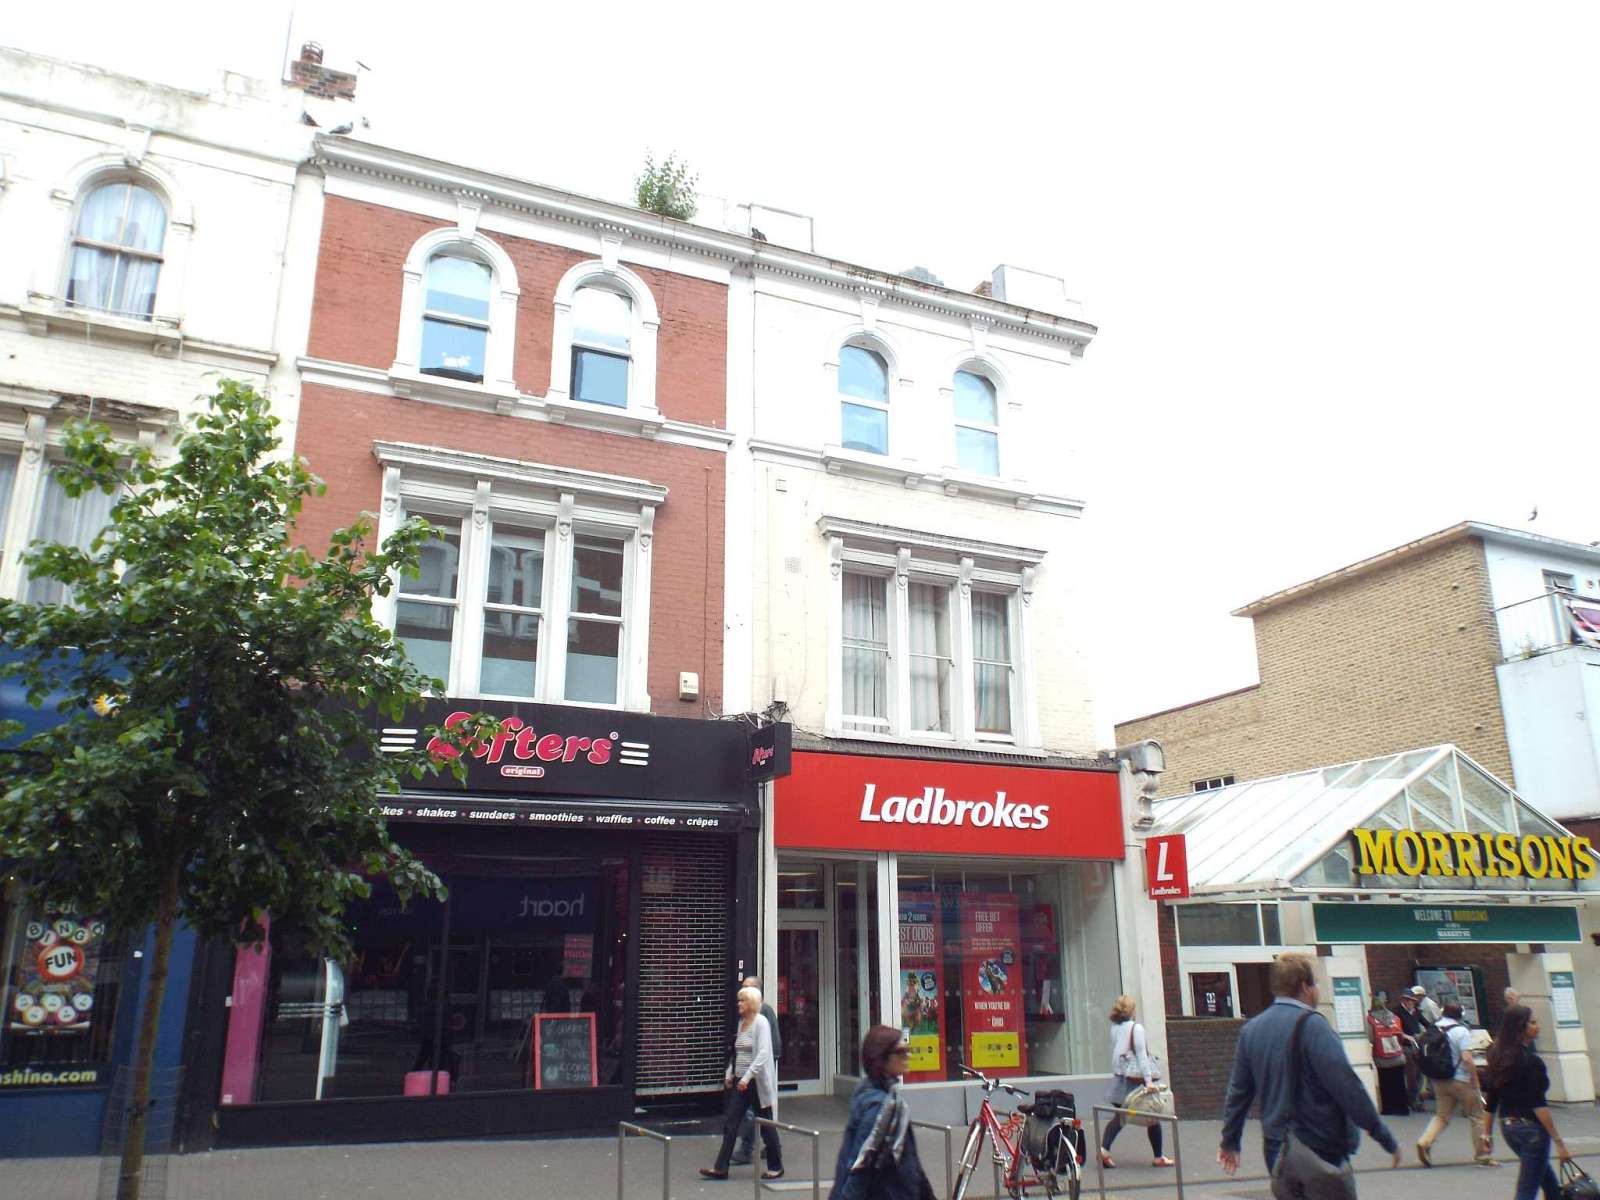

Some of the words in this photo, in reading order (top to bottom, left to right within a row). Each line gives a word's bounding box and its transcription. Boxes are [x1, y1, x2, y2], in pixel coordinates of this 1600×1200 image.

[504, 766, 541, 777] original
[859, 783, 1050, 830] Ladbrokes
[416, 808, 457, 818] shakes
[469, 810, 515, 820] sundaes
[529, 811, 584, 823] smoothies
[596, 813, 633, 824] waffles
[644, 815, 676, 825] coffee
[1157, 842, 1174, 881] L
[1353, 827, 1597, 880] MORRISONS
[1151, 886, 1182, 896] Ladbrokes
[975, 911, 990, 922] FREE
[900, 926, 911, 941] ST
[912, 926, 935, 942] ODDS
[975, 922, 993, 933] OFFER
[900, 942, 935, 955] ARANTEED
[45, 952, 78, 970] FUN
[0, 1068, 97, 1086] shino.com
